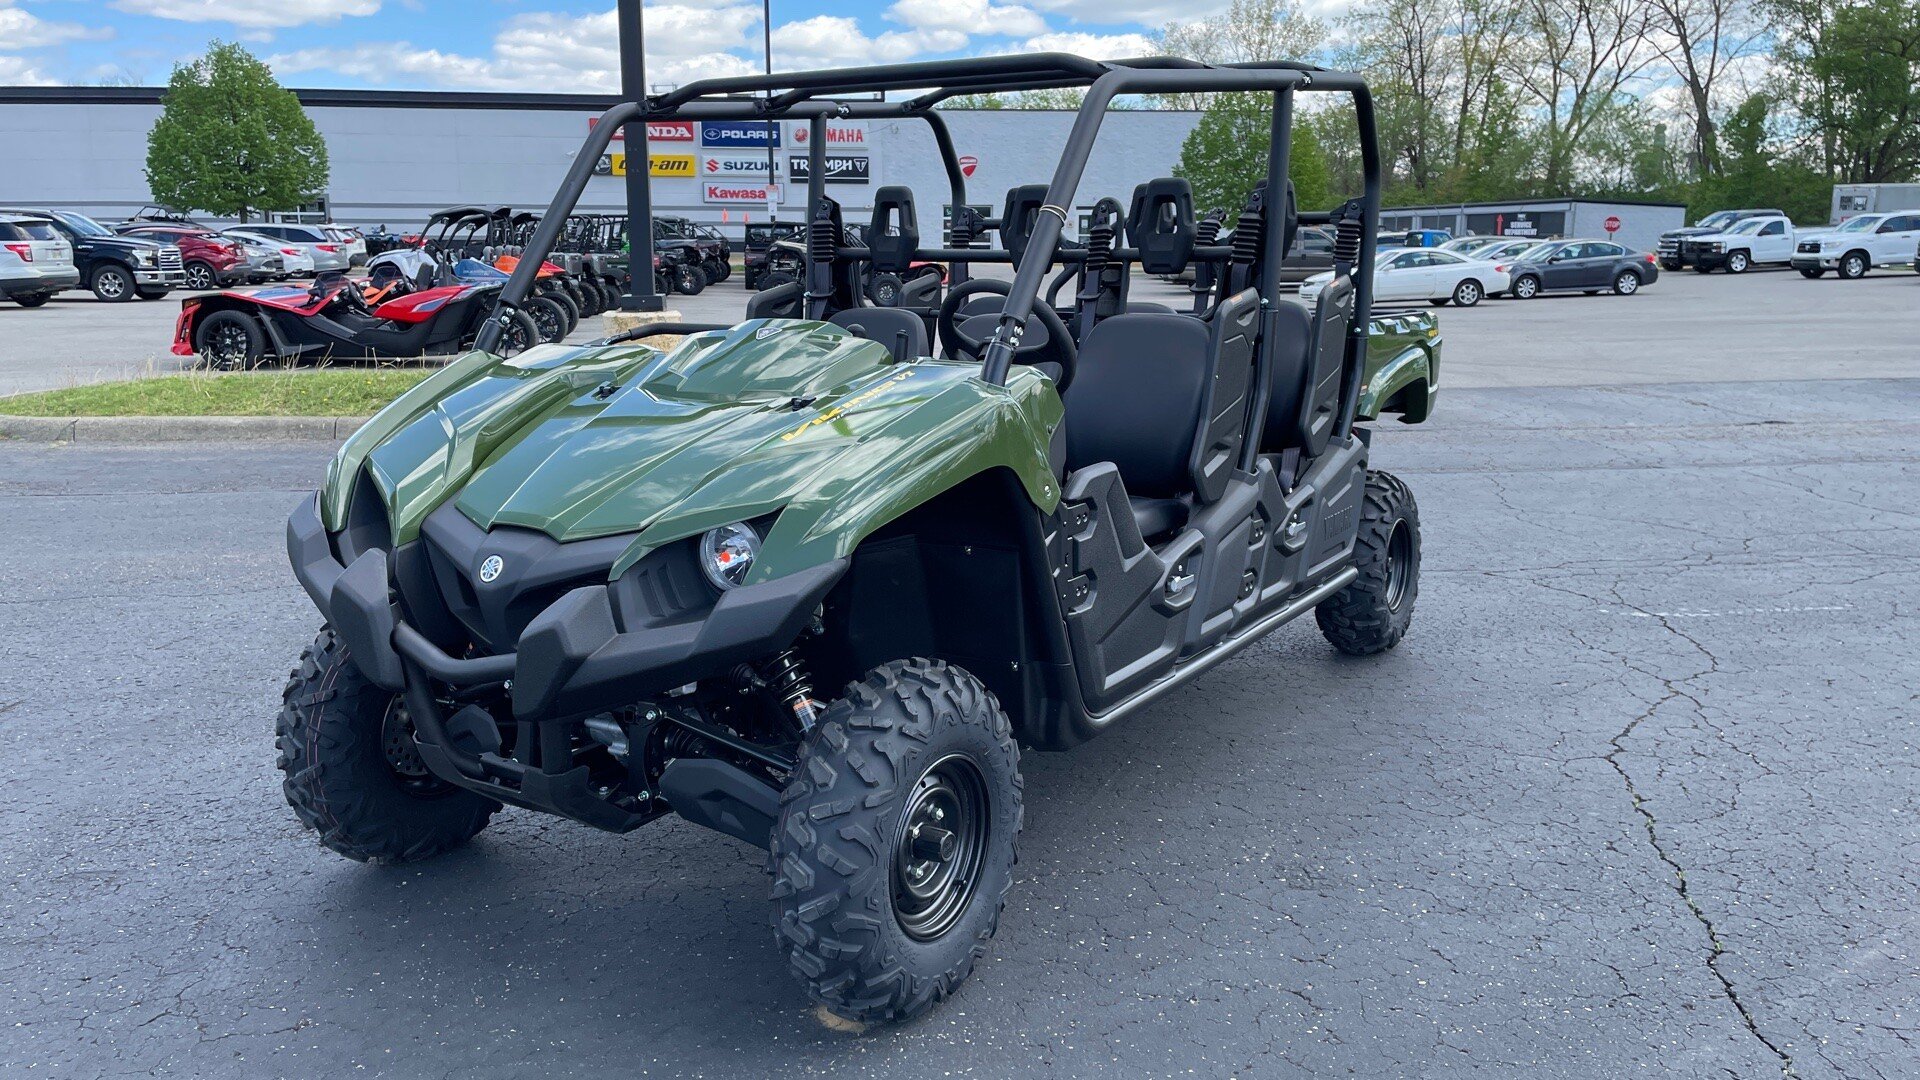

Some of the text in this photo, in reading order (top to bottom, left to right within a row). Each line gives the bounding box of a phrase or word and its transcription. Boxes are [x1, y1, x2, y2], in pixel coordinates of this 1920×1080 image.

[614, 126, 692, 137] NDA
[826, 128, 863, 142] MAHA
[618, 159, 689, 171] c-am
[790, 159, 853, 173] TRMPH
[708, 186, 767, 199] Kawasa
[1605, 221, 1620, 229] STOP
[1504, 228, 1538, 236] DEPARTMENT
